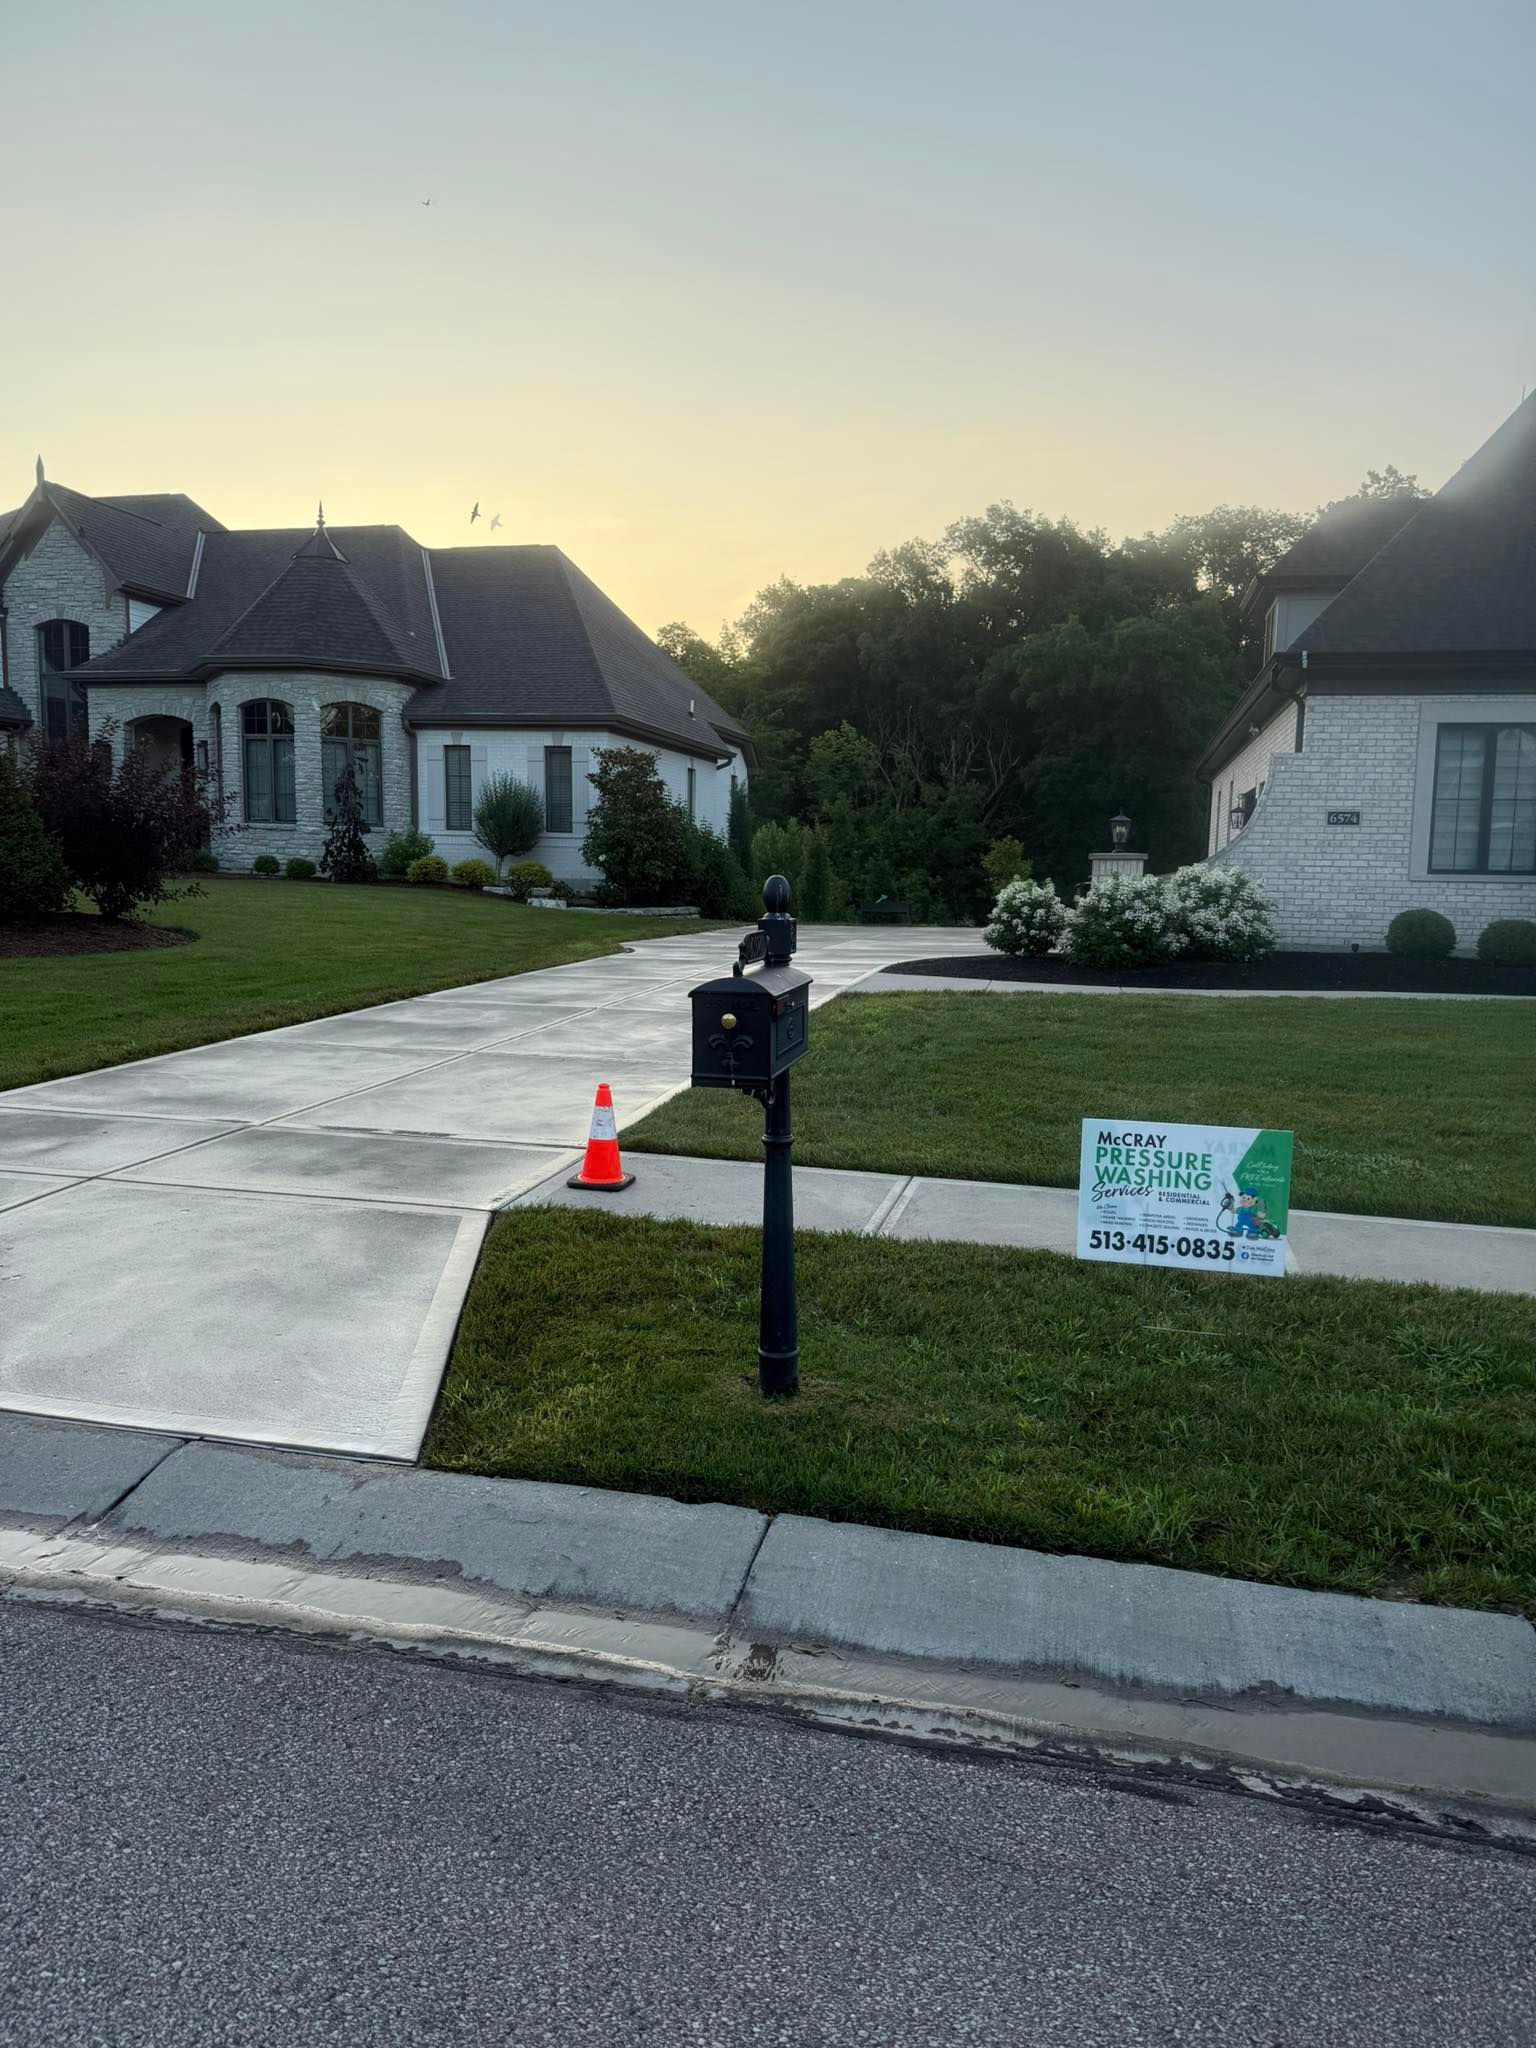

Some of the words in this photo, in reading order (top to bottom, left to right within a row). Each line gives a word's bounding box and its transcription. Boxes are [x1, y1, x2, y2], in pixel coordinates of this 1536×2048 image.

[1330, 812, 1357, 824] 6574
[1097, 1131, 1167, 1148] McCRAY
[1096, 1146, 1212, 1171] PRESSURE
[1094, 1165, 1212, 1191] WASHING
[1091, 1180, 1153, 1203] Services
[1158, 1191, 1200, 1199] RESIDENTIAL
[1165, 1197, 1210, 1206] COMMERCIAL
